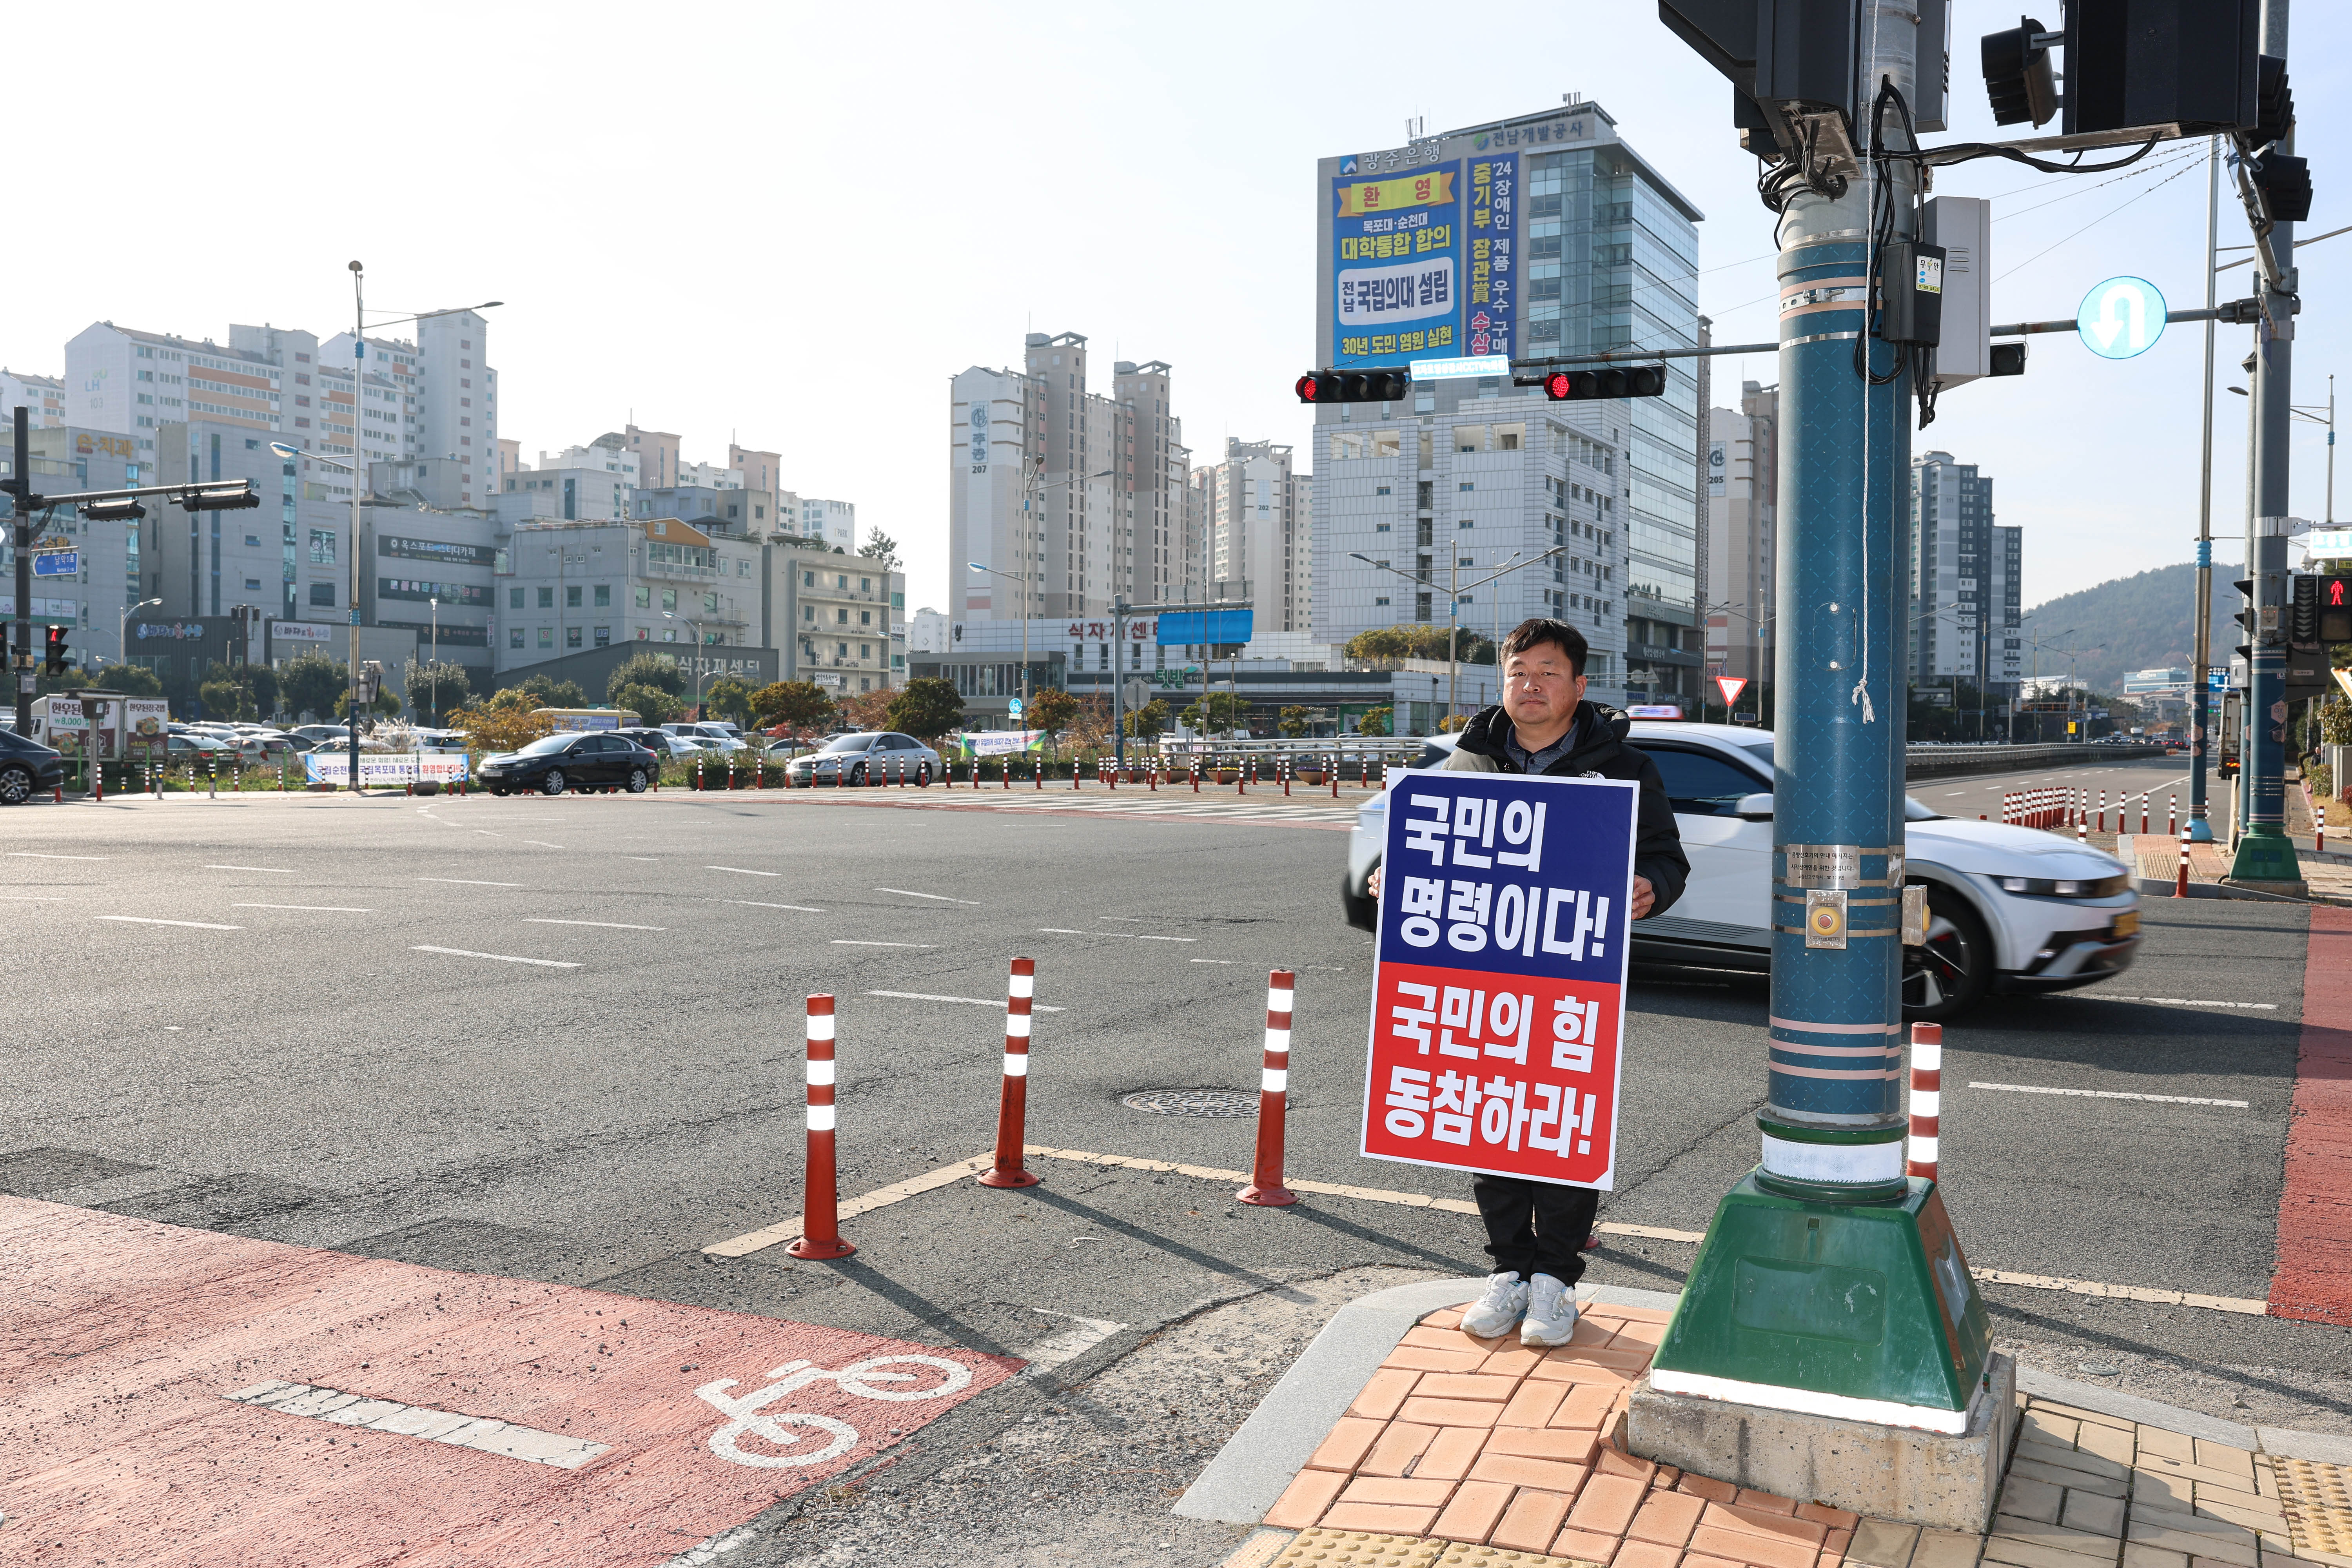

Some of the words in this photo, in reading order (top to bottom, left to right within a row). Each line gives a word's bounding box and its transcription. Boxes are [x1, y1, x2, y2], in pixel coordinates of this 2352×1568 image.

[1493, 121, 1583, 147] 전남개발공사
[1363, 145, 1440, 170] 광주은행
[1474, 163, 1491, 228] 중기부
[1495, 180, 1512, 230] 장애인
[1341, 231, 1411, 260] 대학통합
[1416, 224, 1451, 254] 합의
[1493, 238, 1510, 271] 제품
[1472, 239, 1490, 304] 장관賞
[1342, 281, 1354, 312] 전남
[1357, 276, 1414, 312] 국립의대
[1418, 269, 1448, 306] 설립
[1492, 280, 1510, 313] 우수
[1341, 337, 1368, 356] 30년
[1371, 334, 1397, 353] 도민
[1399, 330, 1425, 352] 염원
[1427, 325, 1452, 348] 실현
[1471, 311, 1490, 356] 수상
[1492, 321, 1509, 354] 구매
[972, 465, 987, 474] 207
[401, 540, 434, 551] 옥스포드
[438, 544, 475, 557] 스터디카페
[1155, 669, 1185, 690] 텃밭
[1405, 794, 1546, 872] 국민의
[1401, 876, 1610, 961] 명령이다!
[1392, 981, 1534, 1065] 국민의
[1551, 995, 1599, 1073] 힘
[1385, 1065, 1597, 1158] 동참하라!
